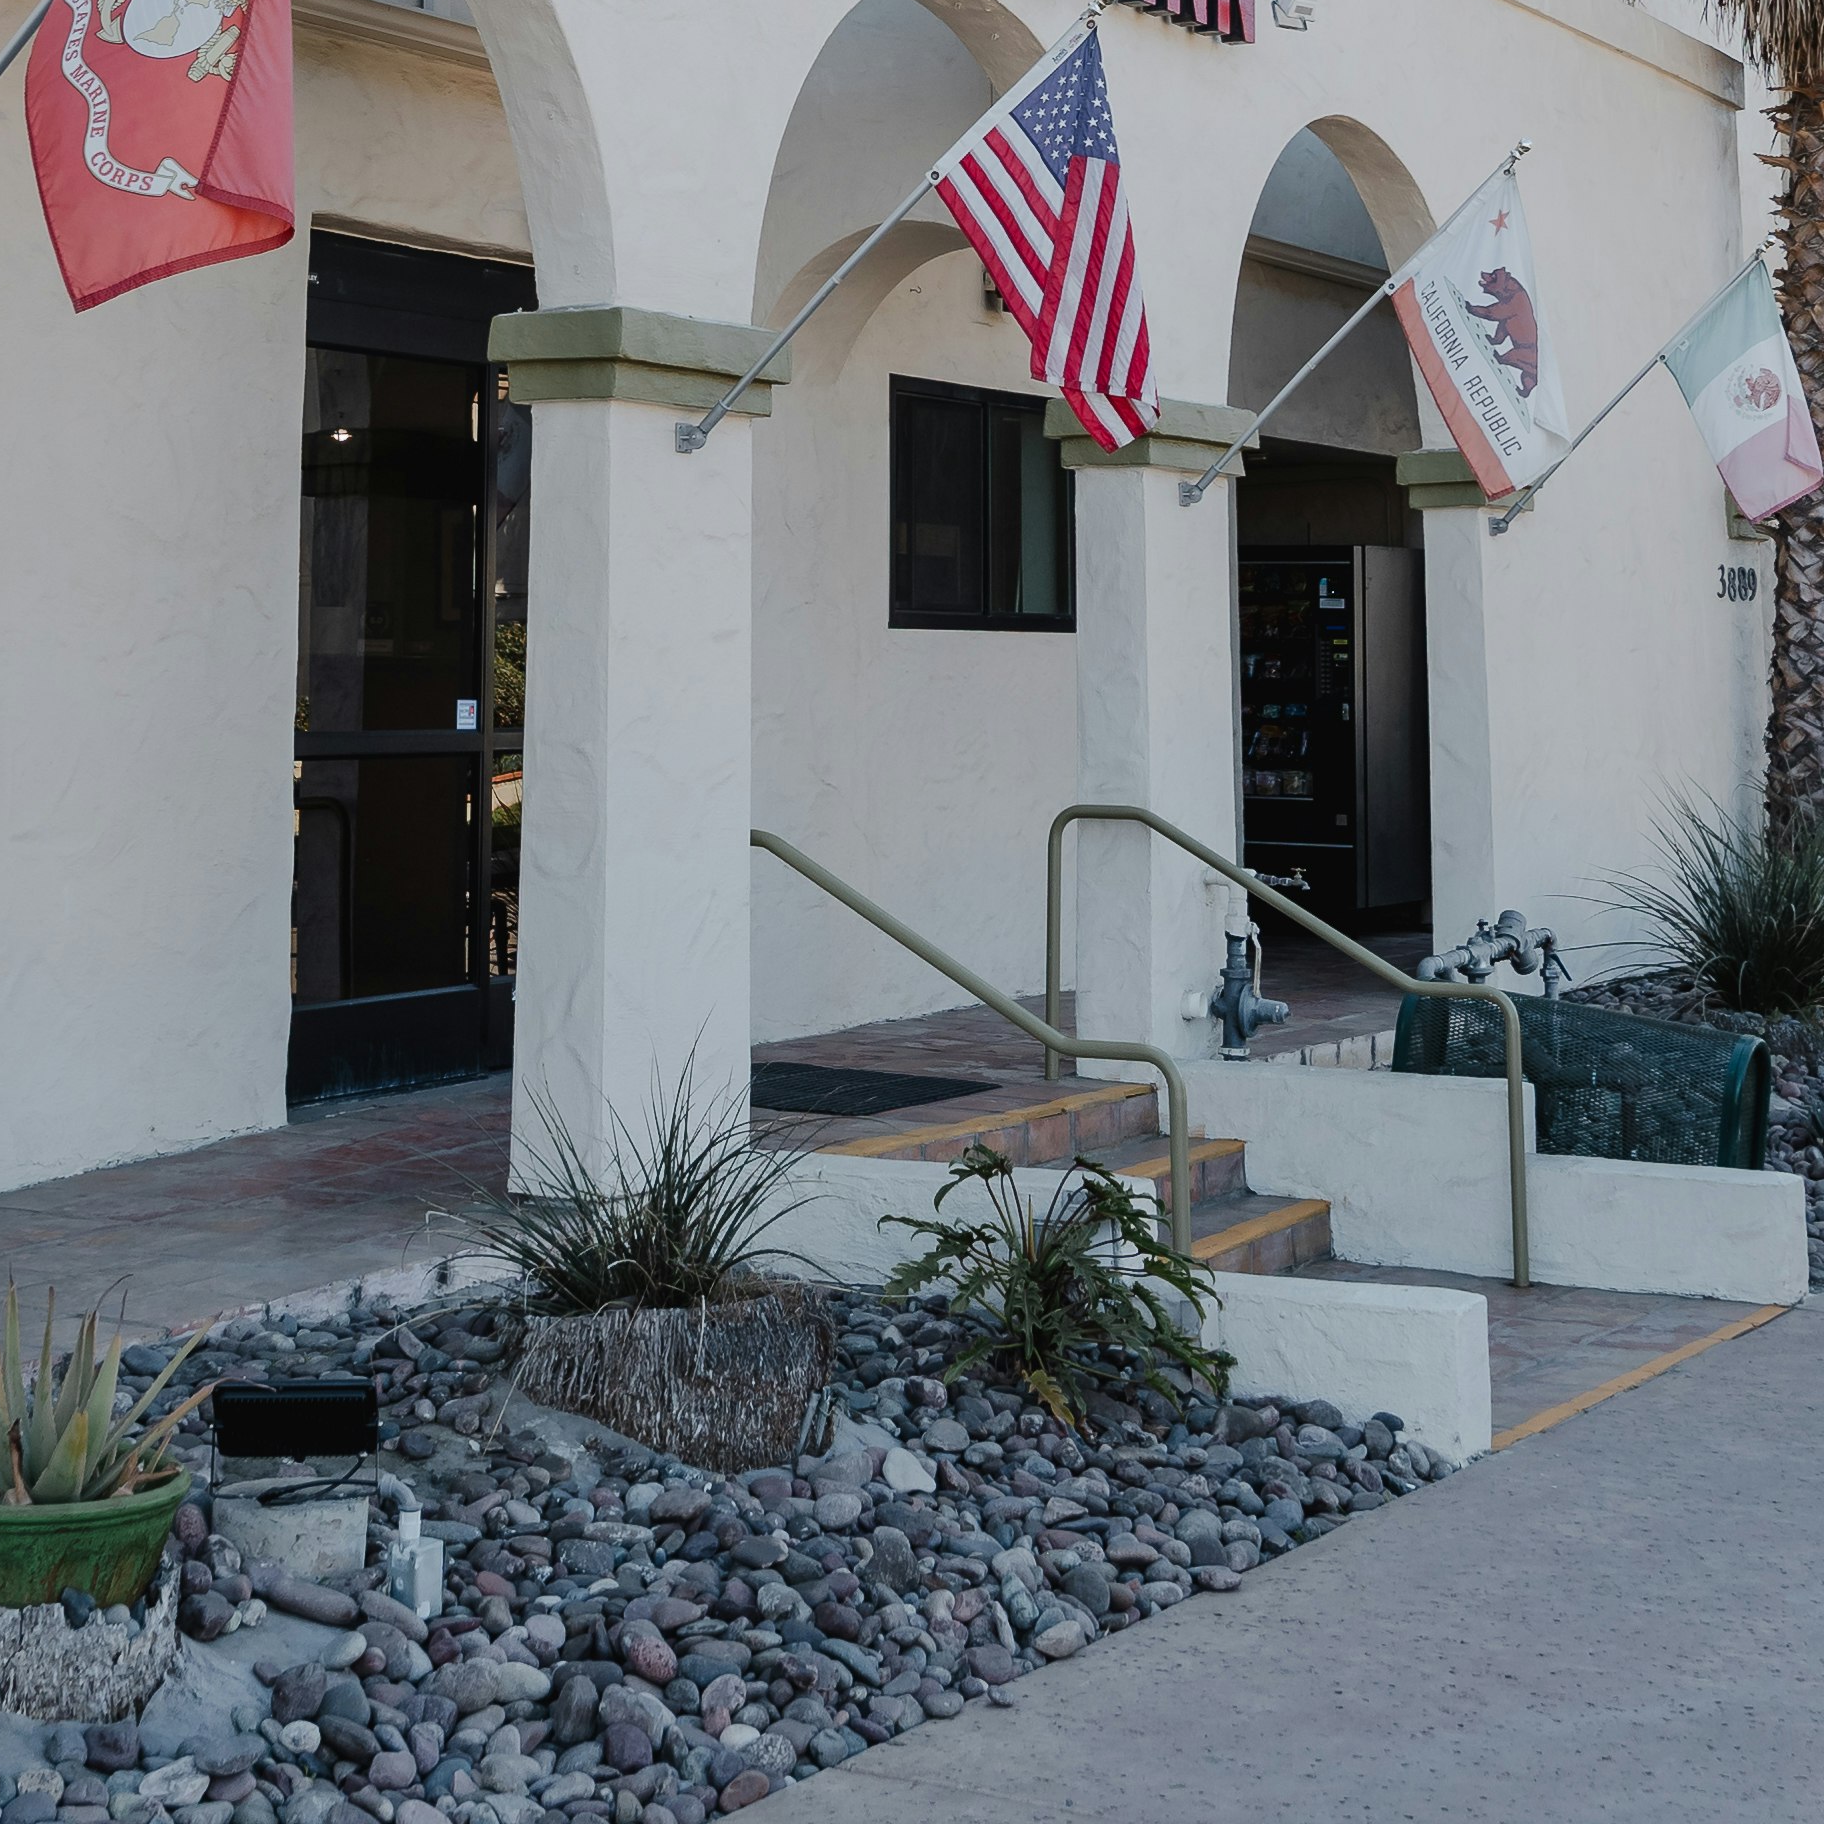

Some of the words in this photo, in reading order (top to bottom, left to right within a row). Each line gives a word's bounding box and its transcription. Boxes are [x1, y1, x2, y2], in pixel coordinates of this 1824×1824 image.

[70, 64, 107, 138] MARINE
[90, 151, 154, 192] CORPS
[1421, 281, 1469, 371] CALIFORNIA
[1463, 375, 1522, 457] REPUBLIC
[1716, 563, 1757, 602] 3889
